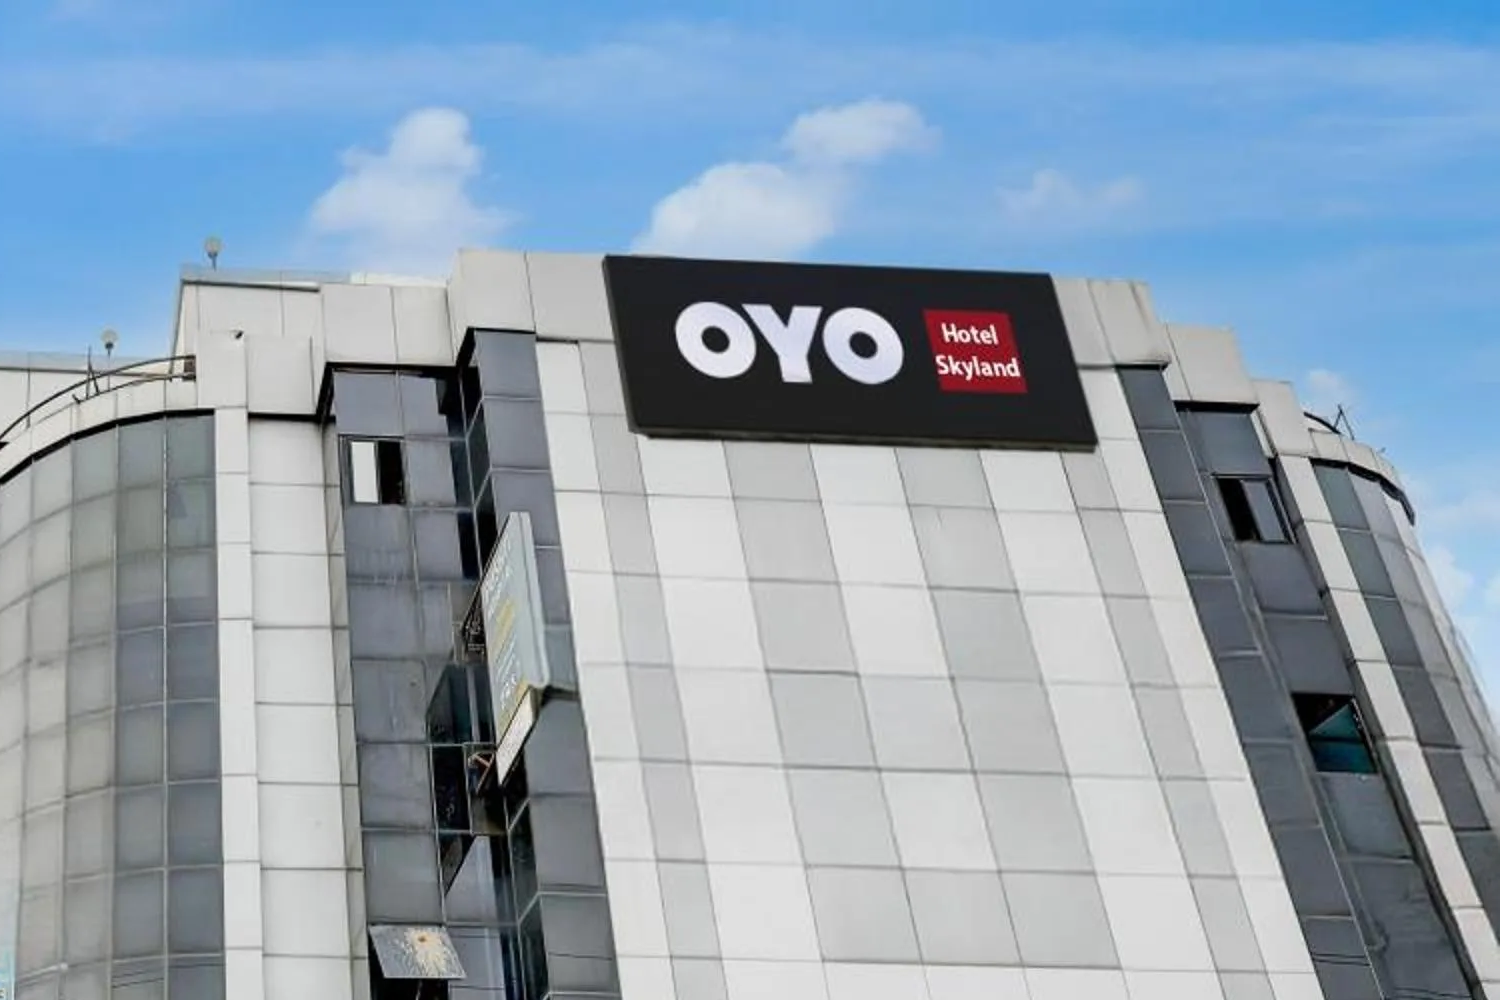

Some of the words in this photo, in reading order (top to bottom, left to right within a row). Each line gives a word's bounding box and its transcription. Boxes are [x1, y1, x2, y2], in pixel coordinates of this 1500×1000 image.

[675, 301, 904, 384] OYO
[941, 322, 999, 346] Hotel
[934, 354, 1021, 380] Skyland
